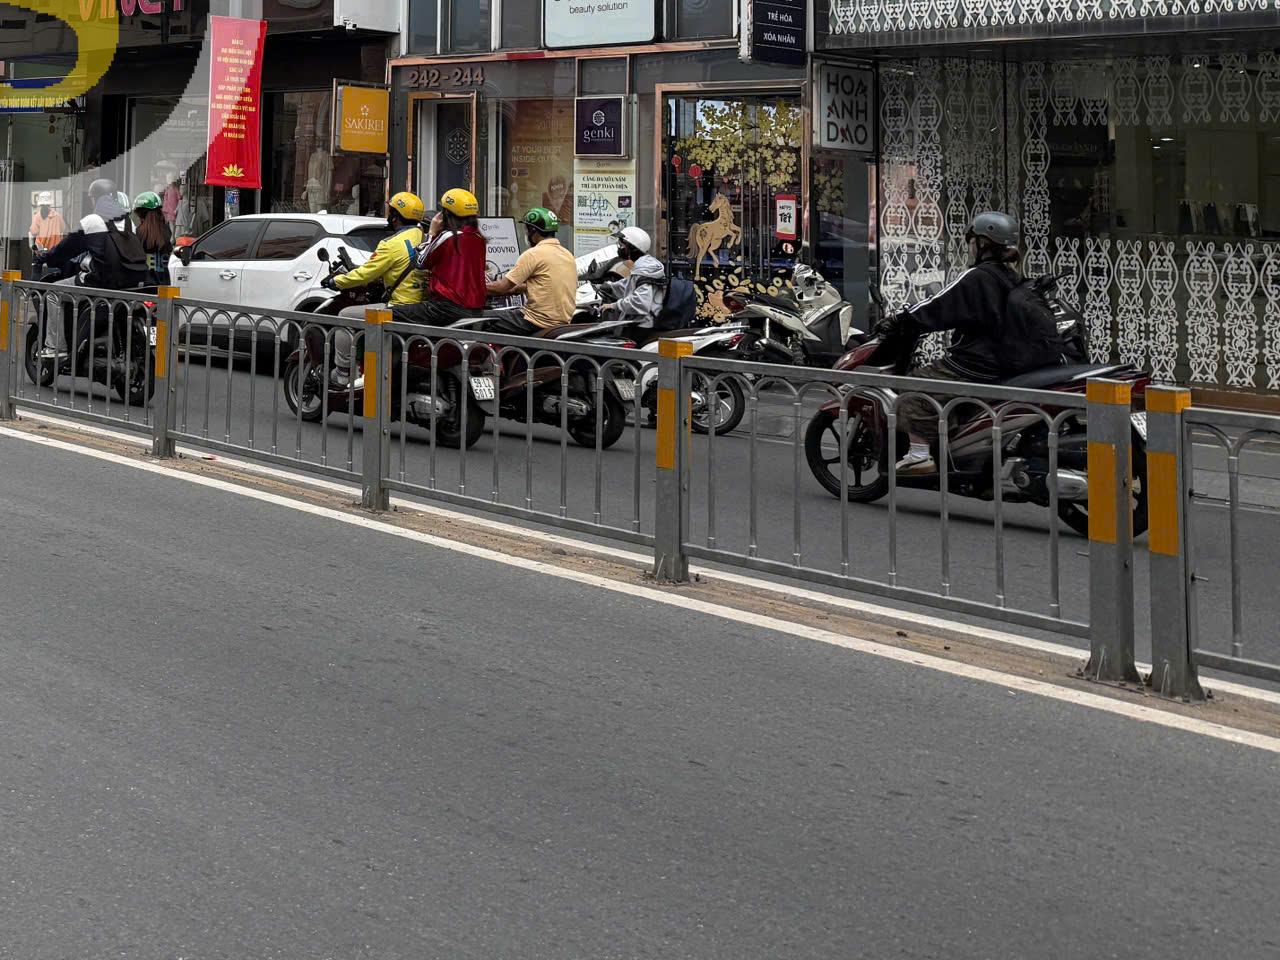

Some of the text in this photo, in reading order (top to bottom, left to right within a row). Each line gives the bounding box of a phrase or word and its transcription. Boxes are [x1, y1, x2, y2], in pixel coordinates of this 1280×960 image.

[570, 2, 628, 14] beauty solution
[827, 72, 868, 98] HOA
[827, 98, 868, 122] ANH
[344, 116, 384, 132] SAKIREI
[583, 127, 614, 142] genki
